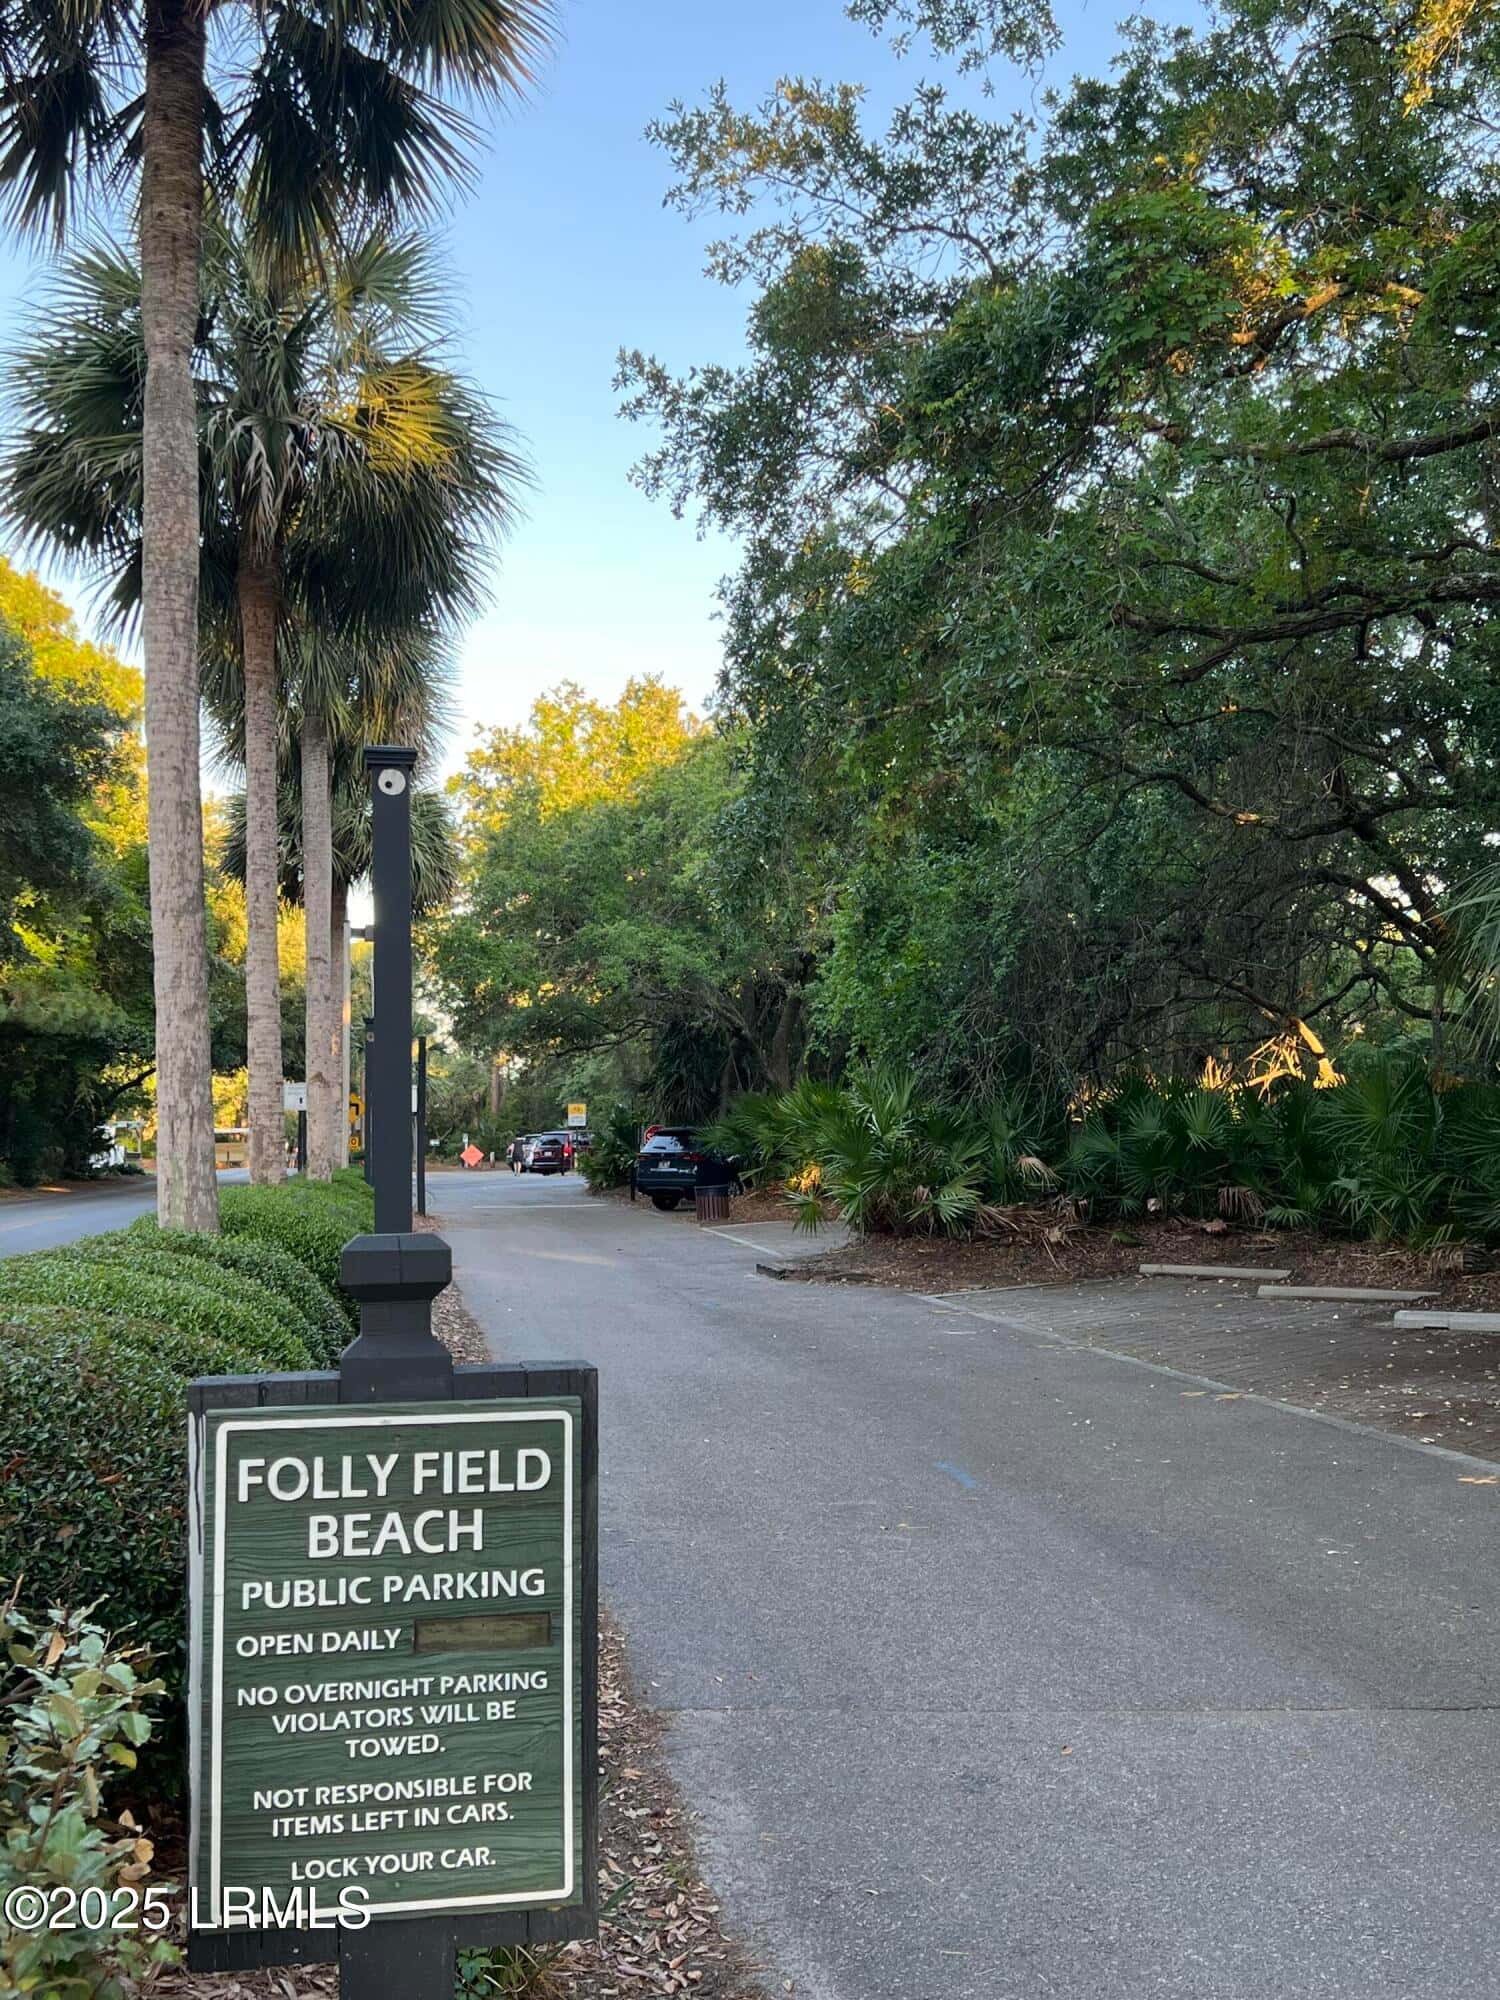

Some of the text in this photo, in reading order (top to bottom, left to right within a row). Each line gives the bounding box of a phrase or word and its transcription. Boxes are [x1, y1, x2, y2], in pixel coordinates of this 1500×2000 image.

[238, 1448, 551, 1503] FOLLY FIELD
[308, 1508, 483, 1559] BEACH
[242, 1568, 545, 1610] PUBLIC PARKING
[236, 1628, 402, 1657] OPEN DAILY
[237, 1670, 548, 1707] NO OVERNIGHT PARKING
[272, 1699, 517, 1734] VIOLATORS WILL BE
[344, 1733, 446, 1758] TOWED.
[253, 1771, 533, 1810] NOT RESPONSIBLE FOR
[272, 1801, 515, 1838] ITEMS LEFT IN CARS.
[291, 1846, 497, 1881] LOCK YOUR CAR.
